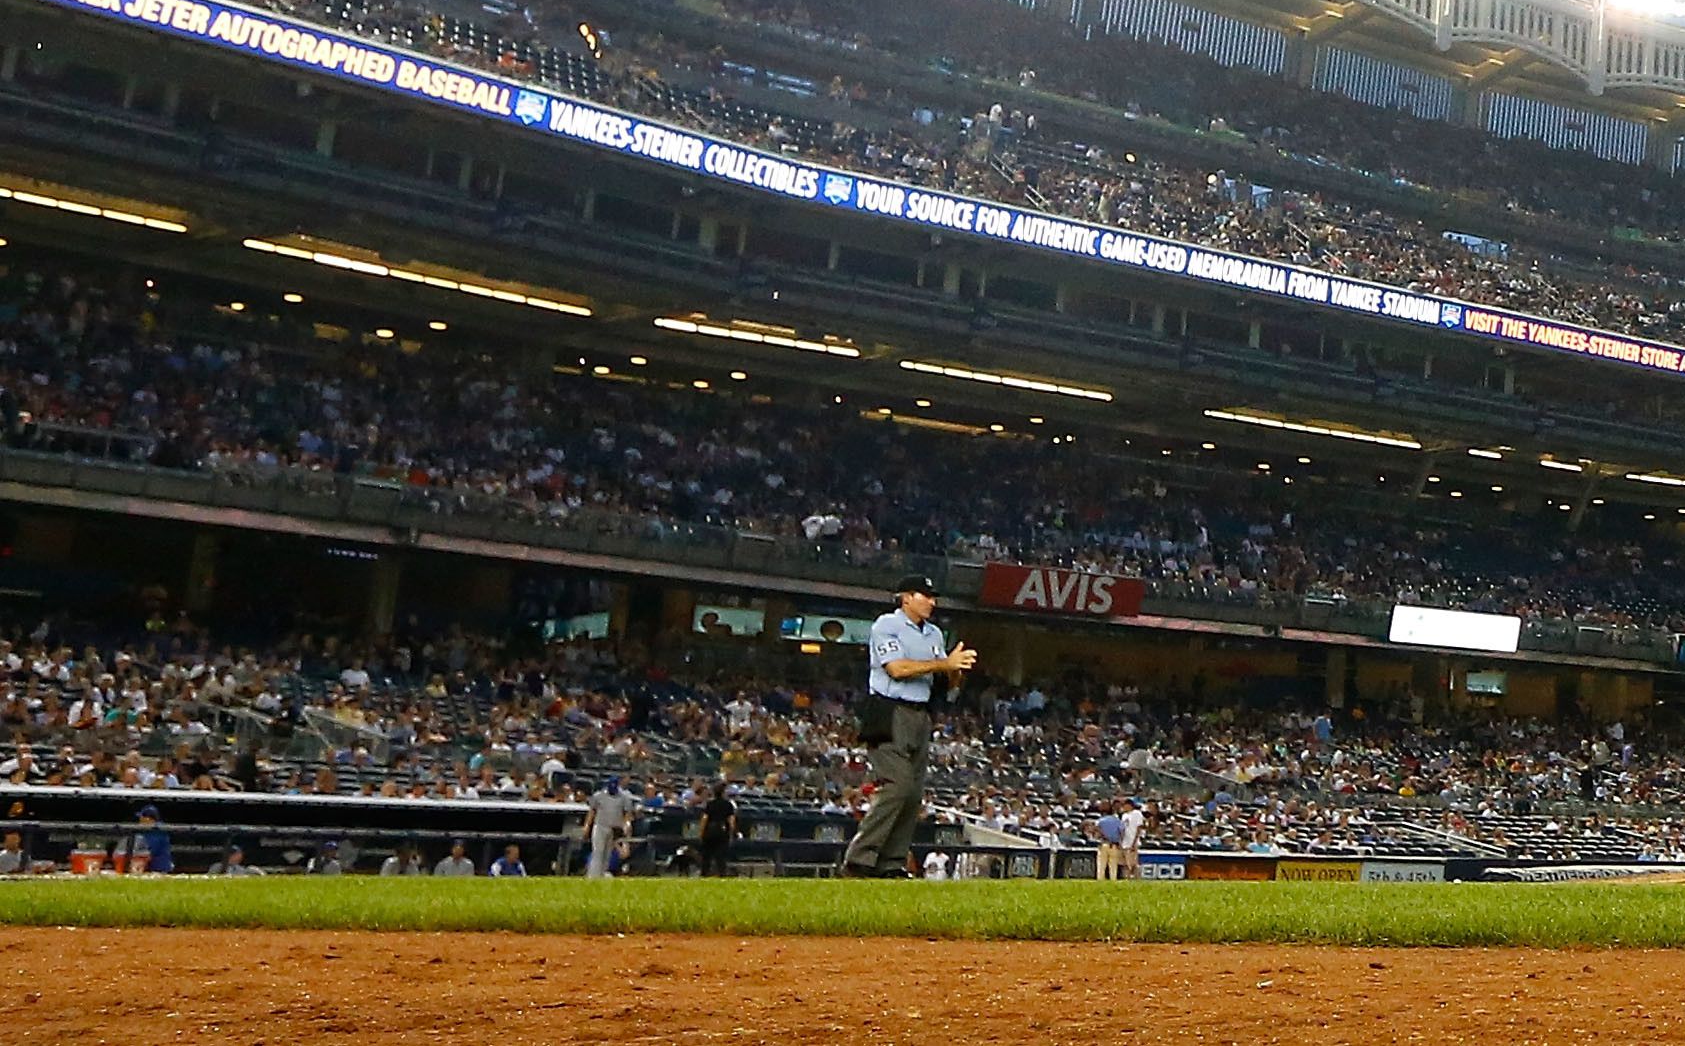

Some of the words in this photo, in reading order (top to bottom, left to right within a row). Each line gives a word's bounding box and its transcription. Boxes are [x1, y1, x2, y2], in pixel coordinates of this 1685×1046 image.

[210, 10, 395, 83] AUTOGRAPHED
[396, 61, 512, 115] BASEBALL
[549, 99, 702, 169] YANKEES-STEINER
[704, 139, 818, 198] COLLECTIBLES
[856, 181, 904, 216] YOUR
[908, 196, 973, 230] SOURCE
[975, 207, 1011, 237] FOR
[1010, 215, 1097, 255] AUTHENTIC
[1100, 236, 1187, 273] GAME-USED
[1187, 251, 1287, 294] MEMORABILIA
[1287, 272, 1328, 303] FROM
[1329, 279, 1381, 312] YANKEE
[1381, 292, 1440, 324] STADIUM
[1465, 310, 1501, 334] VISIT
[1500, 317, 1527, 339] THE
[1528, 323, 1640, 363] YANKEES-STEINER
[1642, 347, 1679, 370] STORE
[1014, 570, 1117, 614] AVIS
[877, 640, 899, 656] 55
[1141, 864, 1185, 879] EICO
[1280, 869, 1314, 882] NOW
[1318, 869, 1356, 882] OPEN
[1368, 871, 1390, 882] 5th
